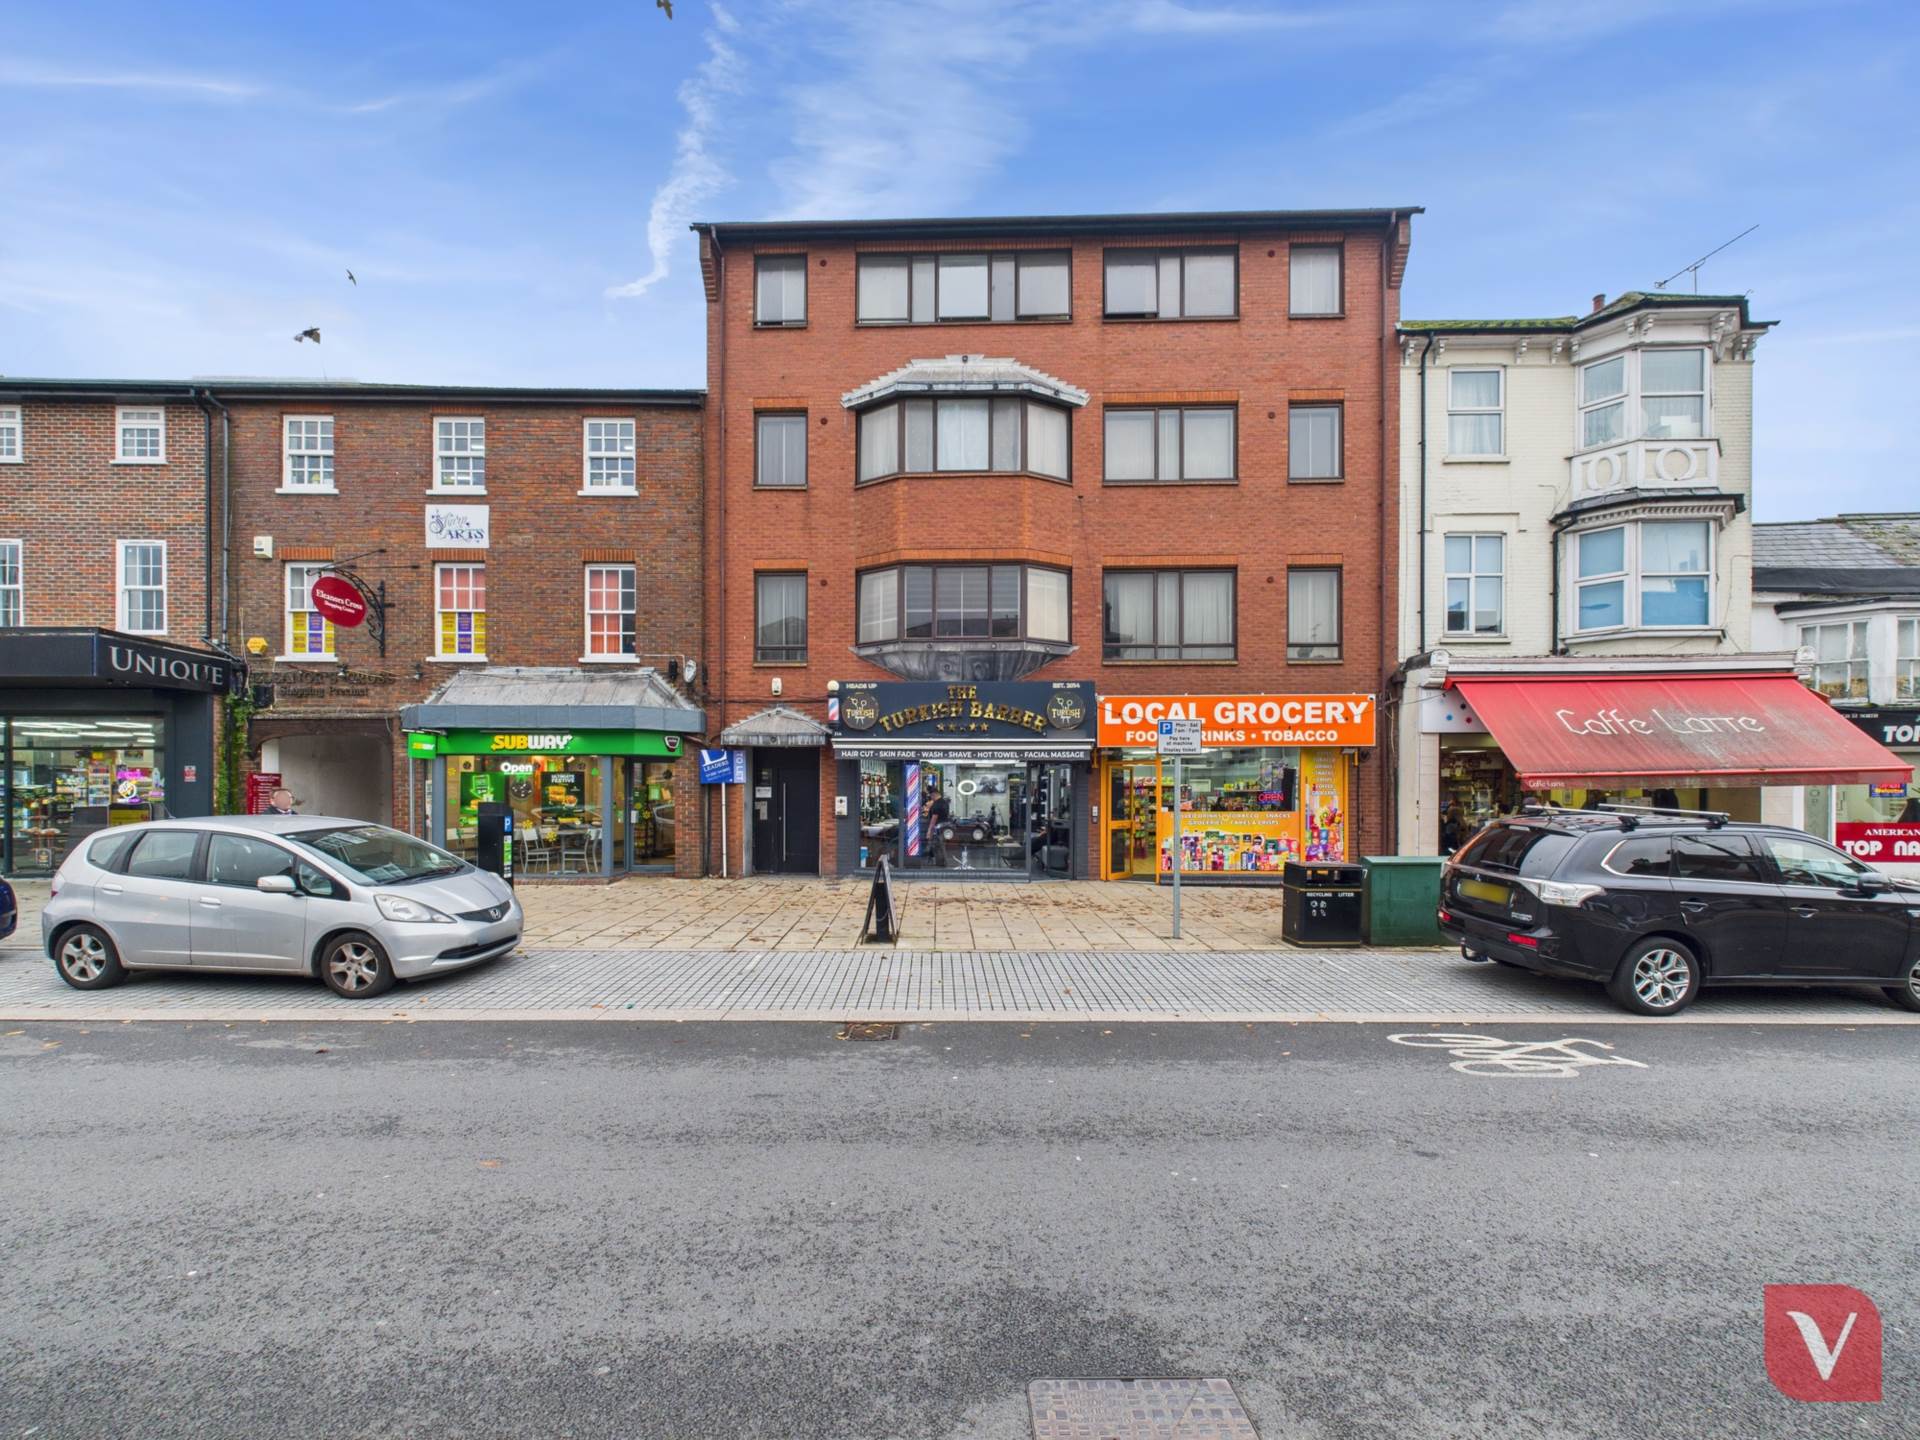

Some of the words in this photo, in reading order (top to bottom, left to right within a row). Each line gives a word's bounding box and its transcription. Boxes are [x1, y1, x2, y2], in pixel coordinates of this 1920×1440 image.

[109, 646, 223, 685] UNIQUE
[947, 685, 977, 699] THE
[879, 701, 963, 732] TURKISH
[969, 701, 1048, 733] BARBER
[1104, 702, 1206, 724] LOCAL
[1214, 701, 1368, 725] GROCERY
[1162, 723, 1171, 734] P
[1555, 709, 1654, 735] Caffe
[490, 735, 573, 751] SUBWAY
[1126, 730, 1159, 742] FOO
[1200, 730, 1246, 742] RINKS
[1262, 730, 1338, 742] TOBACCO
[735, 753, 744, 764] TO
[500, 762, 533, 776] Open
[703, 760, 730, 772] LEADERS
[735, 765, 744, 781] LET
[1258, 793, 1285, 801] OPEN
[1865, 828, 1920, 836] AMERICAN
[1842, 840, 1883, 856] TOP
